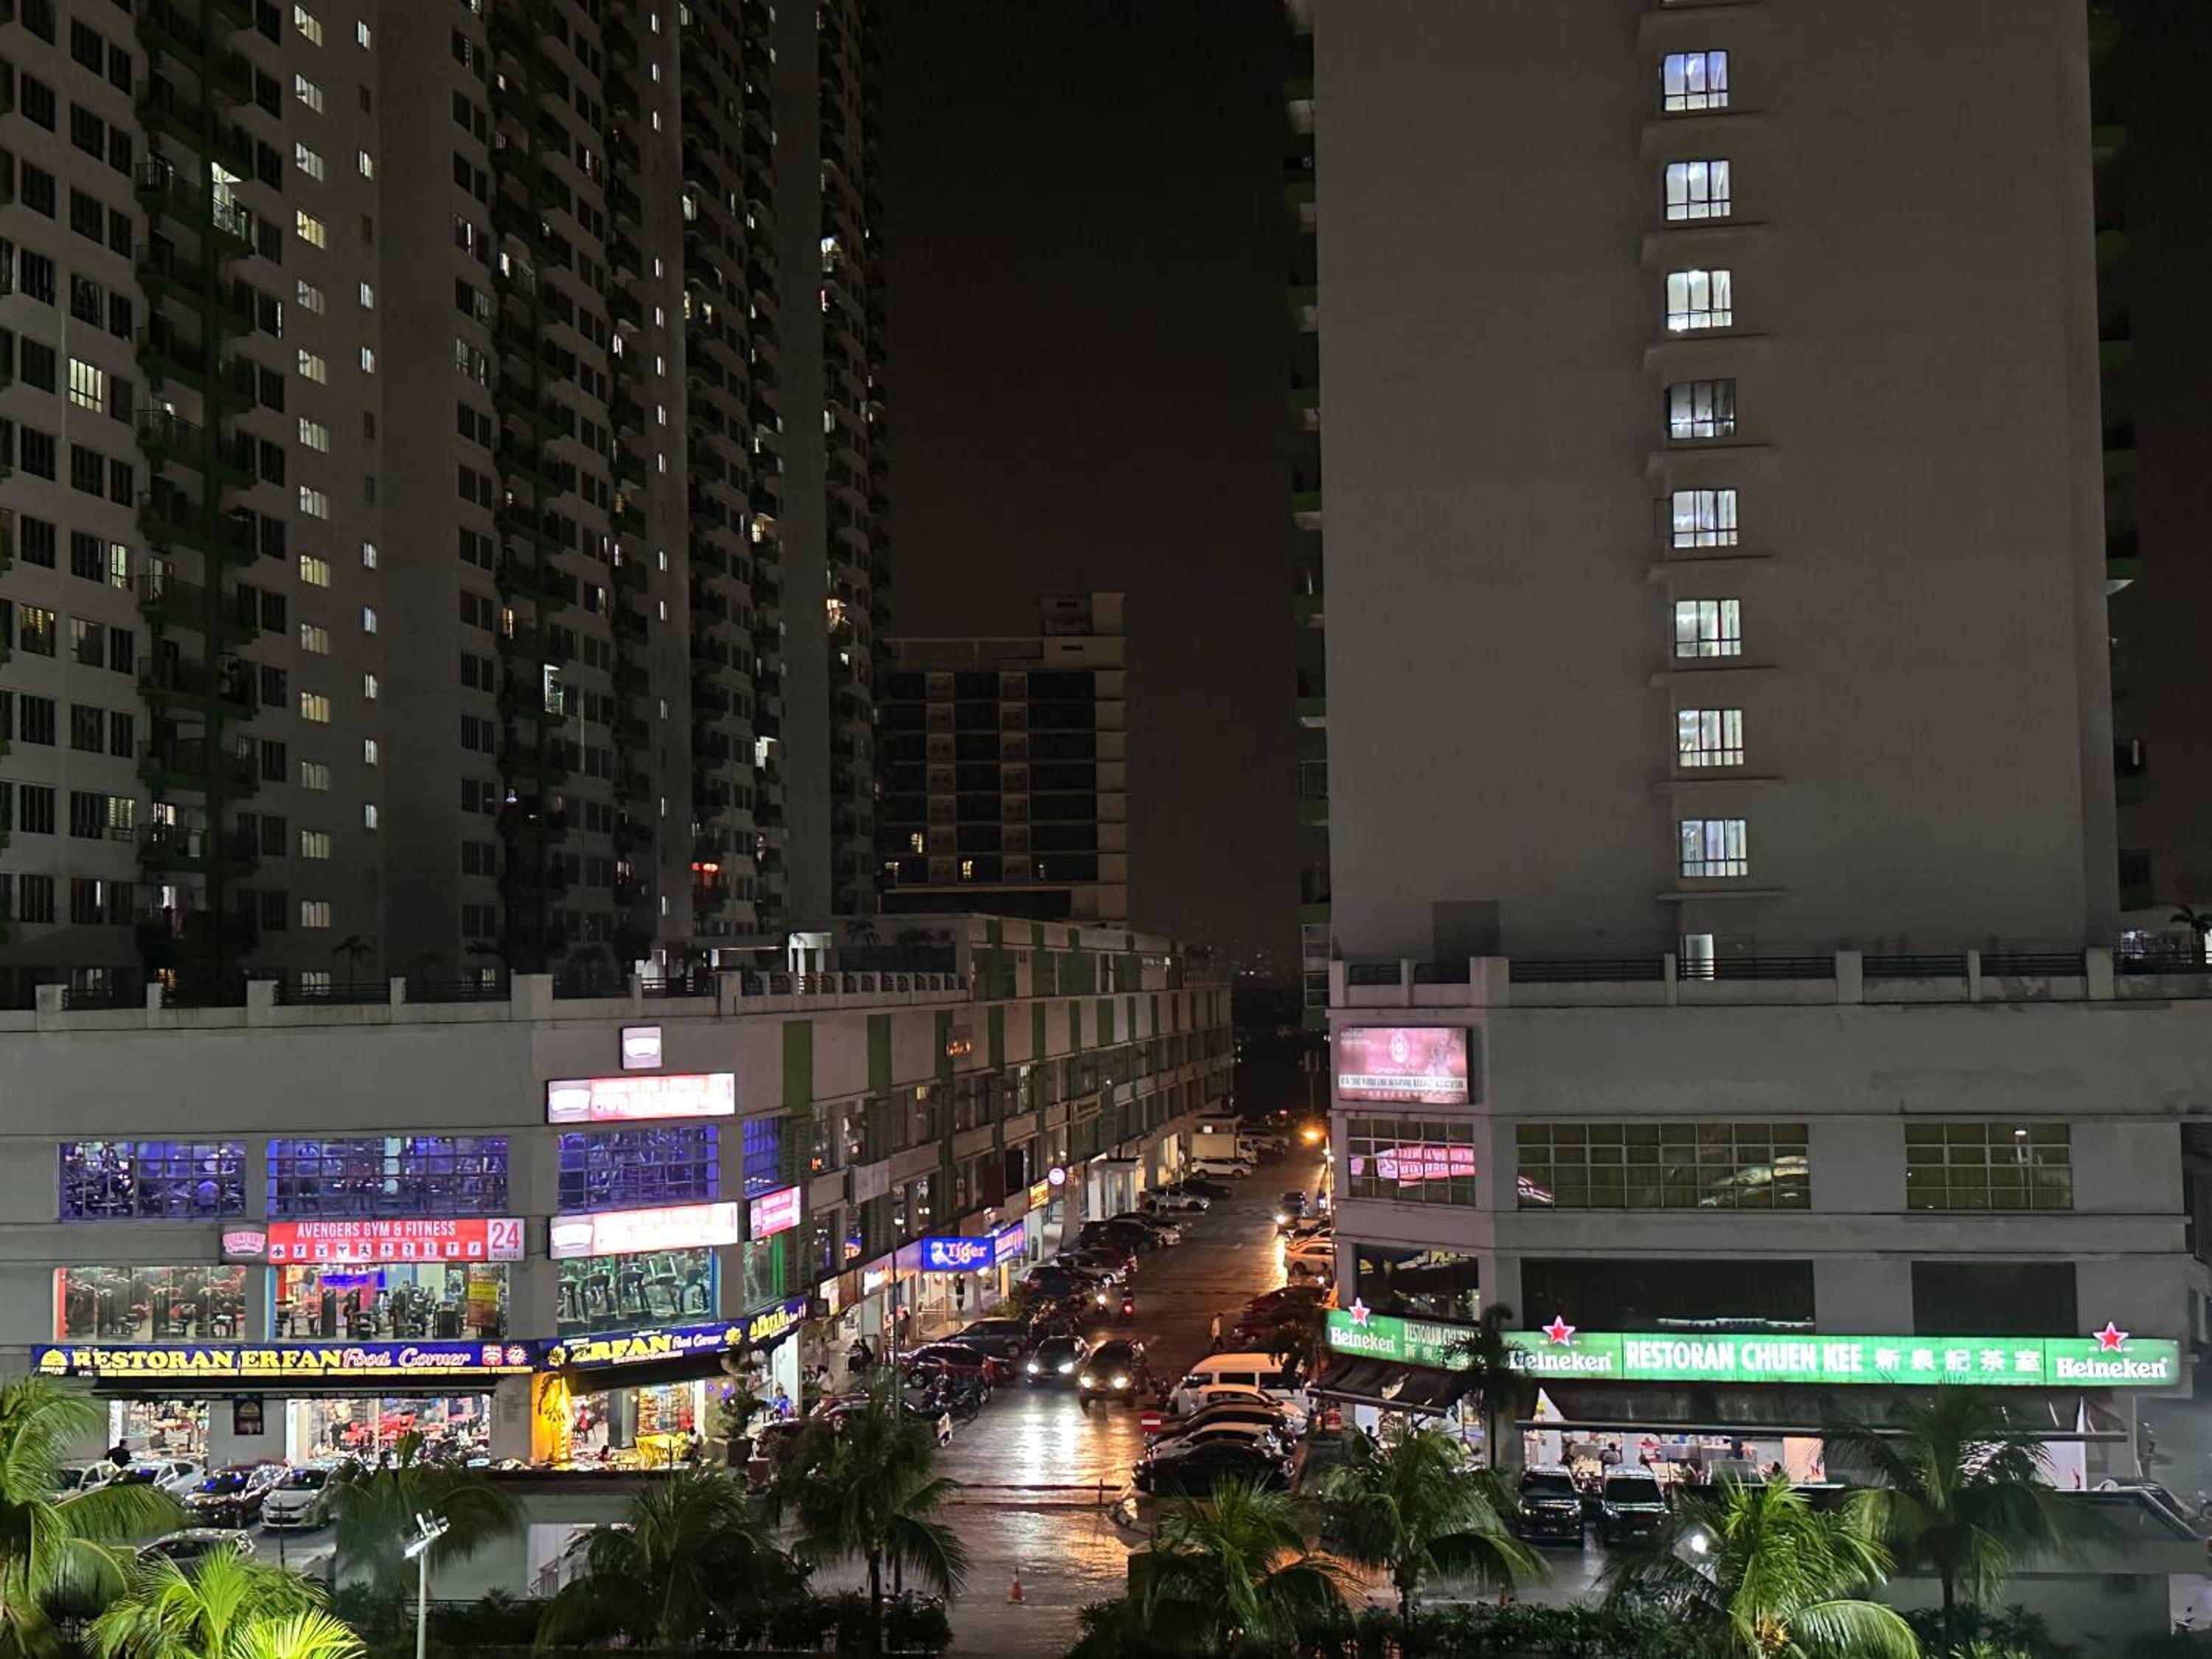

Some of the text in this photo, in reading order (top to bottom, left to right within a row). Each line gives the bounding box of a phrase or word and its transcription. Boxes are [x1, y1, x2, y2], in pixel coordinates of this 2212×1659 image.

[297, 1220, 456, 1238] AVENGERS GYM & FITNESS
[492, 1222, 520, 1249] 24
[947, 1243, 987, 1263] Tiger
[1331, 1326, 1397, 1353] Heineken
[1403, 1322, 1441, 1346] RESTORAN
[72, 1347, 471, 1369] RESTORAN ERFAN Food Corner
[570, 1334, 673, 1363] ERFAN
[1509, 1350, 1613, 1370] Heineken
[1626, 1340, 1864, 1372] RESTORAN CHUEN KEE
[2056, 1357, 2168, 1378] Heineken
